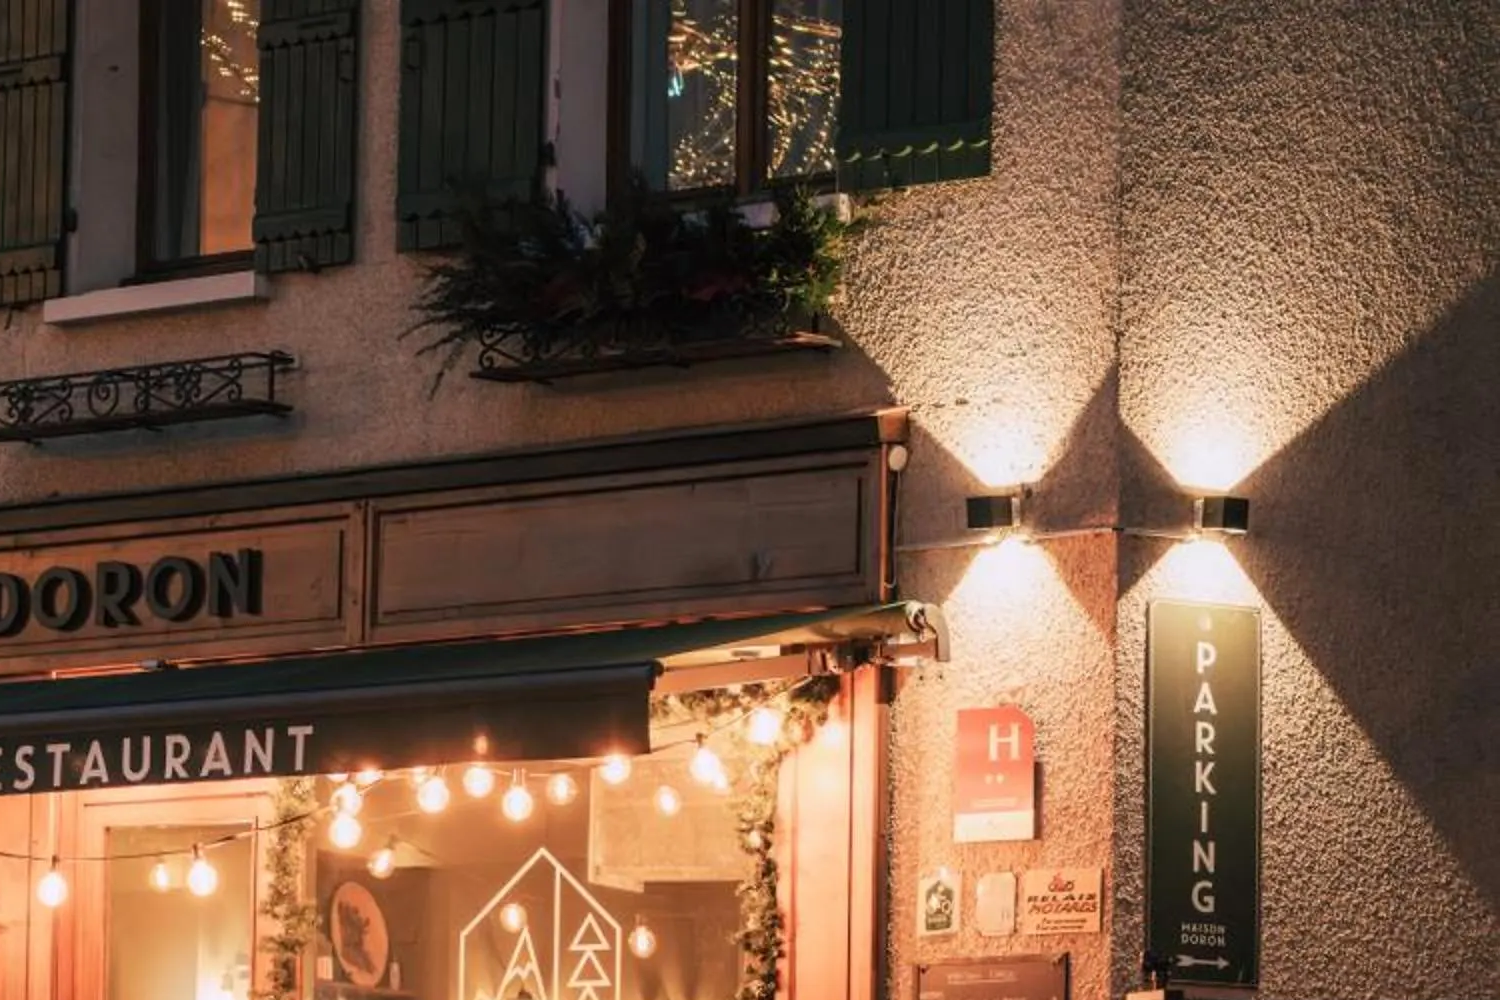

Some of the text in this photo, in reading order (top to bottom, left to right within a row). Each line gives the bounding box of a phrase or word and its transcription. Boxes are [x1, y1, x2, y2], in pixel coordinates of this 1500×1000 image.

[988, 722, 1020, 762] H
[1190, 641, 1218, 913] PARKING
[1181, 922, 1225, 935] MAISON
[1181, 933, 1225, 947] DORON
